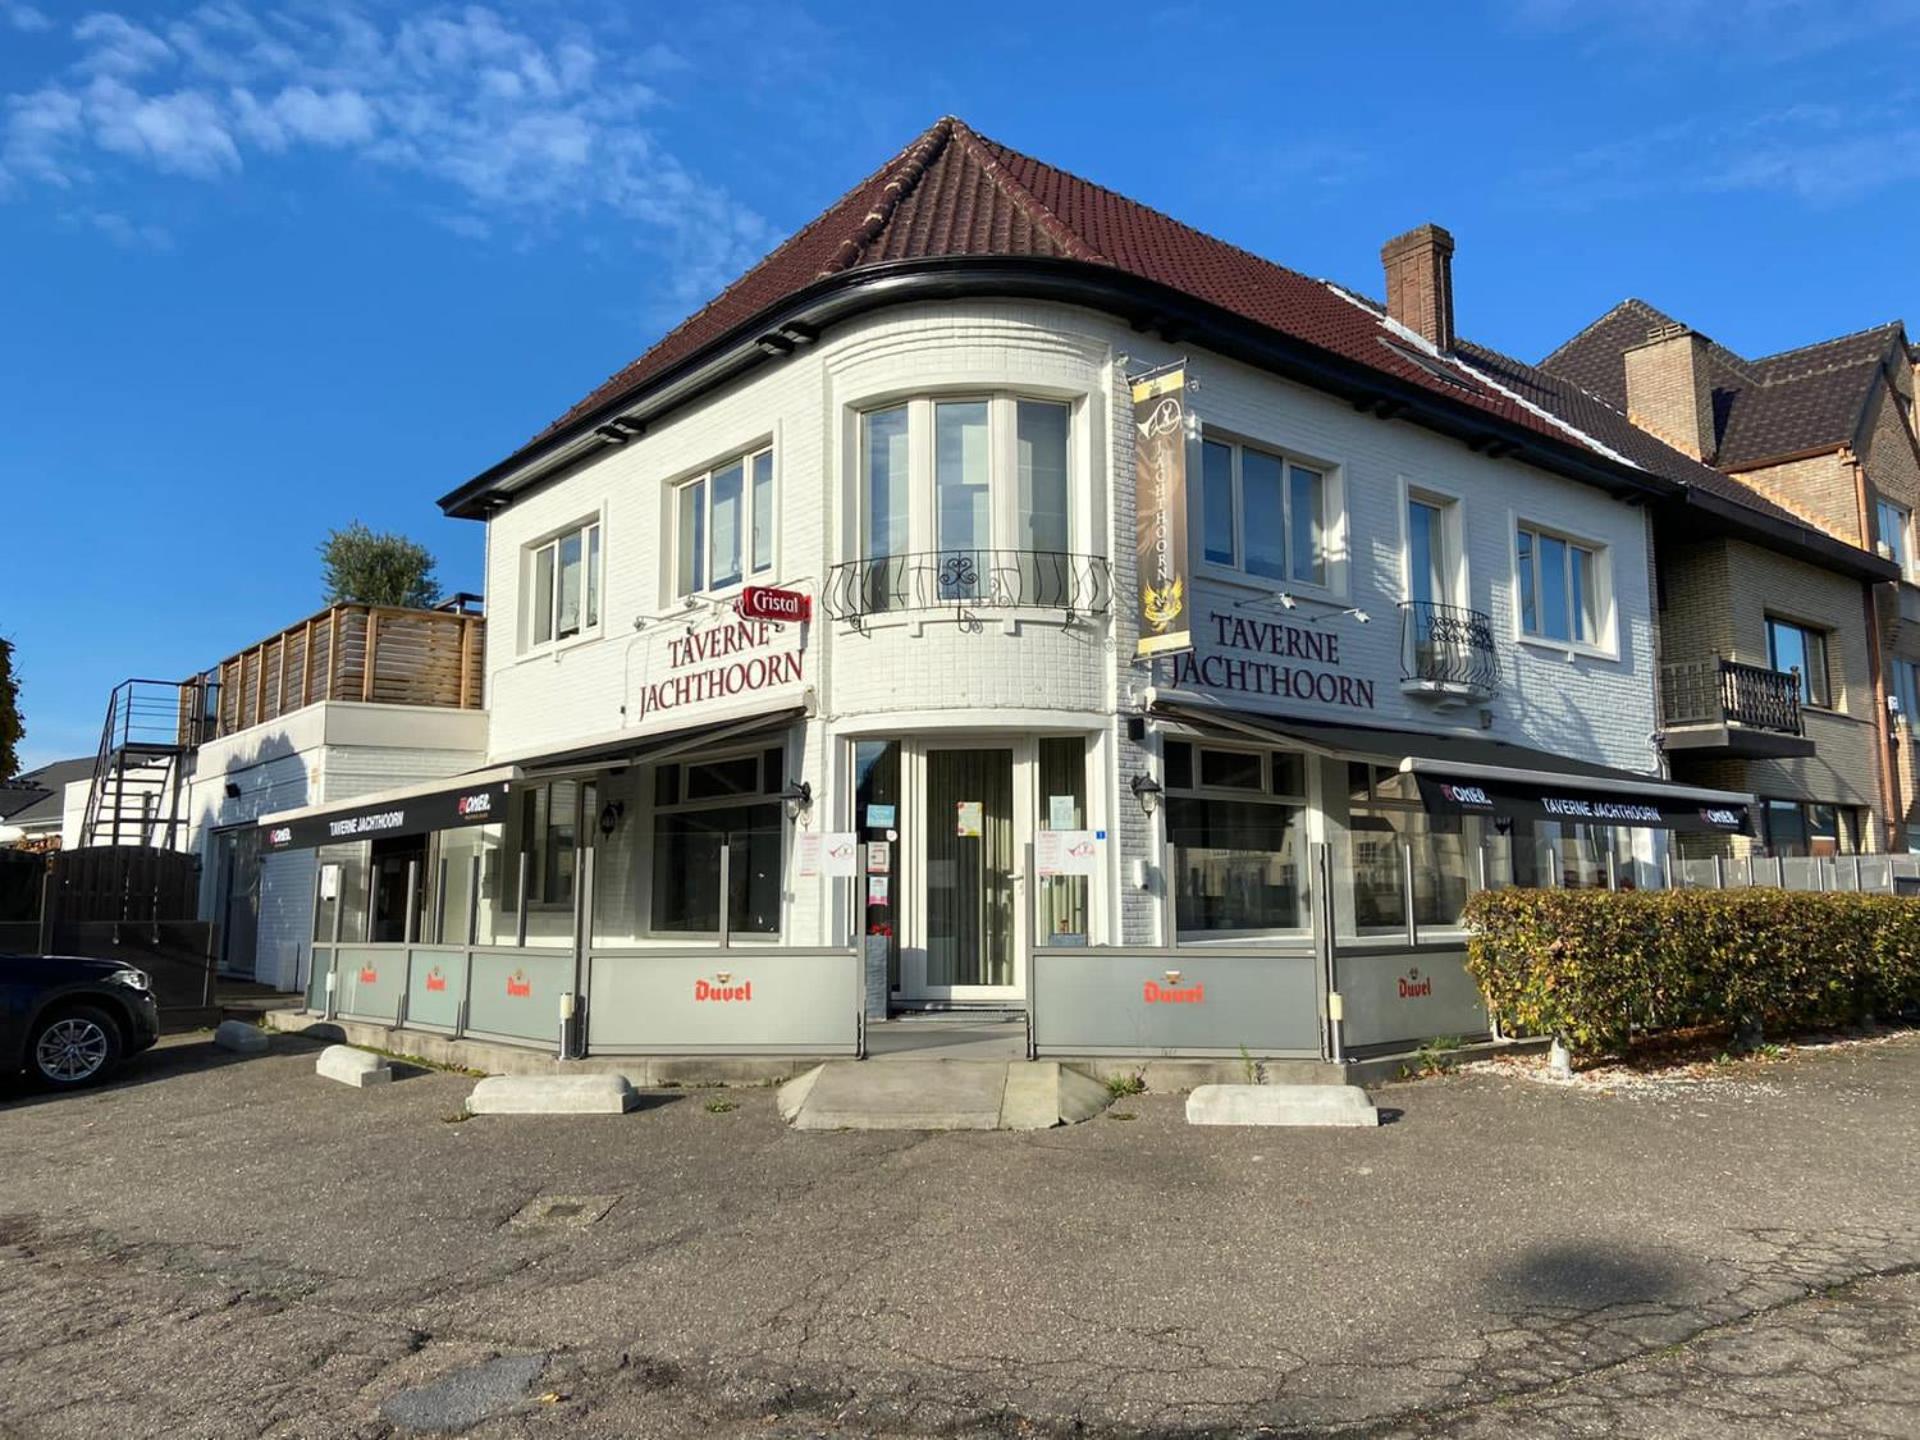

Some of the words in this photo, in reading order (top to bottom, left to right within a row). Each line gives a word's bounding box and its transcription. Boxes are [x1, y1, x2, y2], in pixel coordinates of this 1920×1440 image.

[753, 590, 798, 613] Cristal
[667, 620, 769, 668] TAVERNE
[1210, 611, 1340, 665] TAVERNE
[639, 648, 804, 722] JACHTHOORN
[1172, 650, 1374, 709] JACHTHOORN
[1541, 798, 1593, 816] TAVERNE
[1593, 802, 1662, 821] JACHTHOORN
[695, 979, 752, 1002] Duvel
[1144, 981, 1204, 1004] Duvel
[1398, 976, 1431, 998] Duvel
